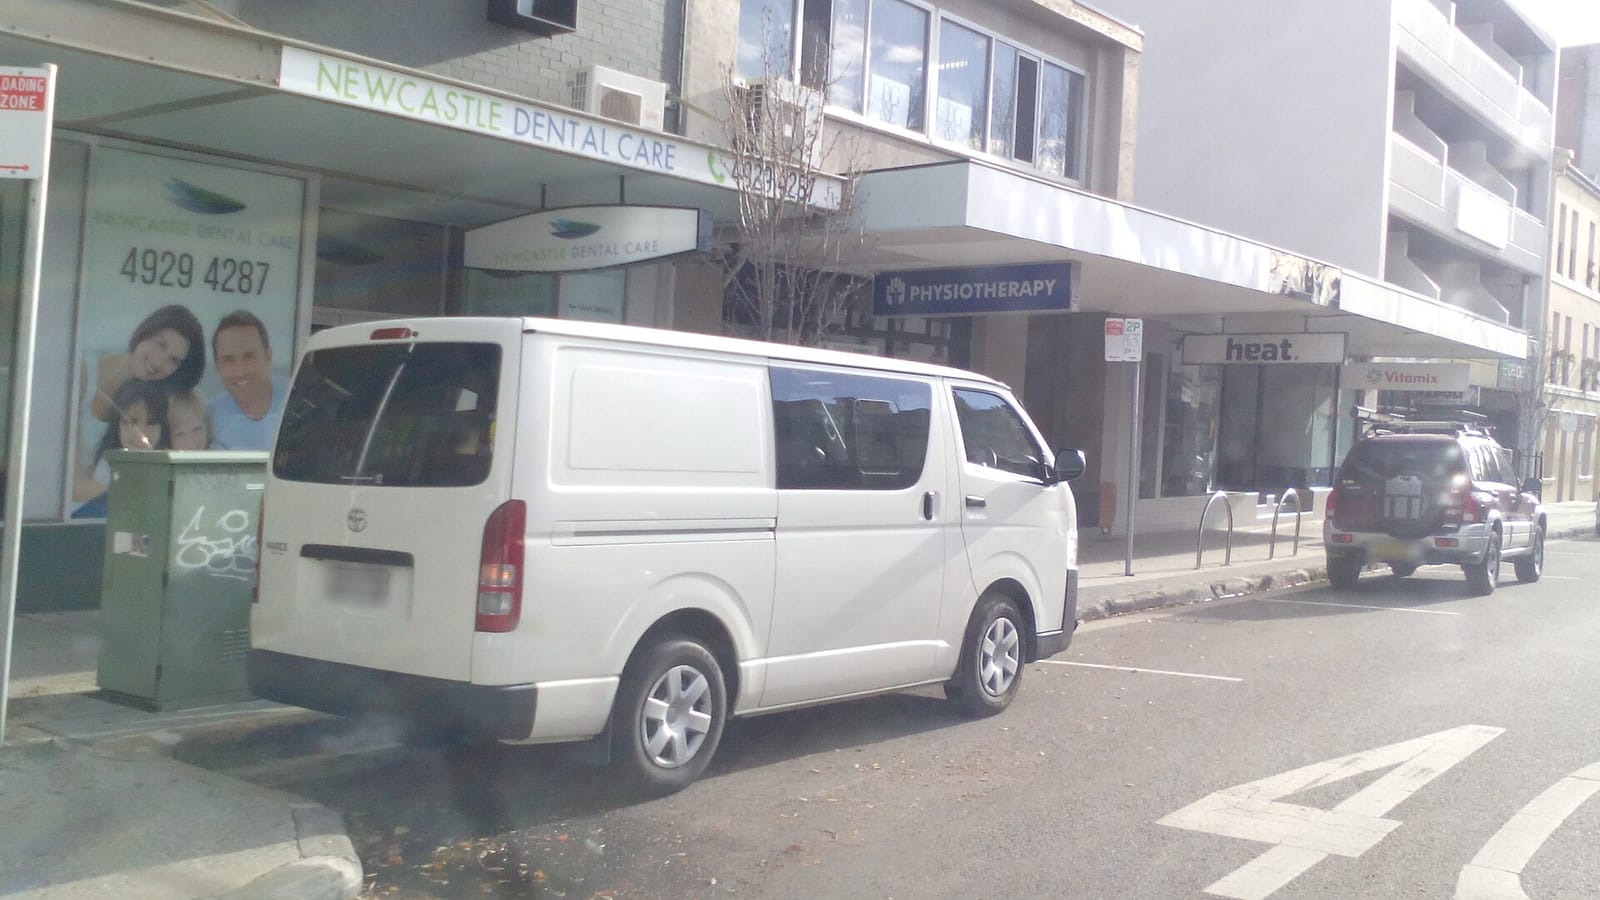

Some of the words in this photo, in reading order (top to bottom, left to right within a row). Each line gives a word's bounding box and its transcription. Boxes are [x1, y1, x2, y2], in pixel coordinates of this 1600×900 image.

[1, 77, 45, 92] OADING
[0, 94, 38, 109] ZONE
[316, 58, 503, 132] NEWCASTLE
[513, 107, 610, 157] DENTAL
[617, 132, 677, 171] CARE
[571, 243, 619, 260] DENTAL
[624, 239, 660, 255] CARE
[120, 247, 194, 288] 4929
[203, 257, 270, 295] 4287
[910, 278, 1056, 301] PHYSIOTHERAPY
[1225, 336, 1299, 361] heat.
[1384, 370, 1439, 385] Vitamix
